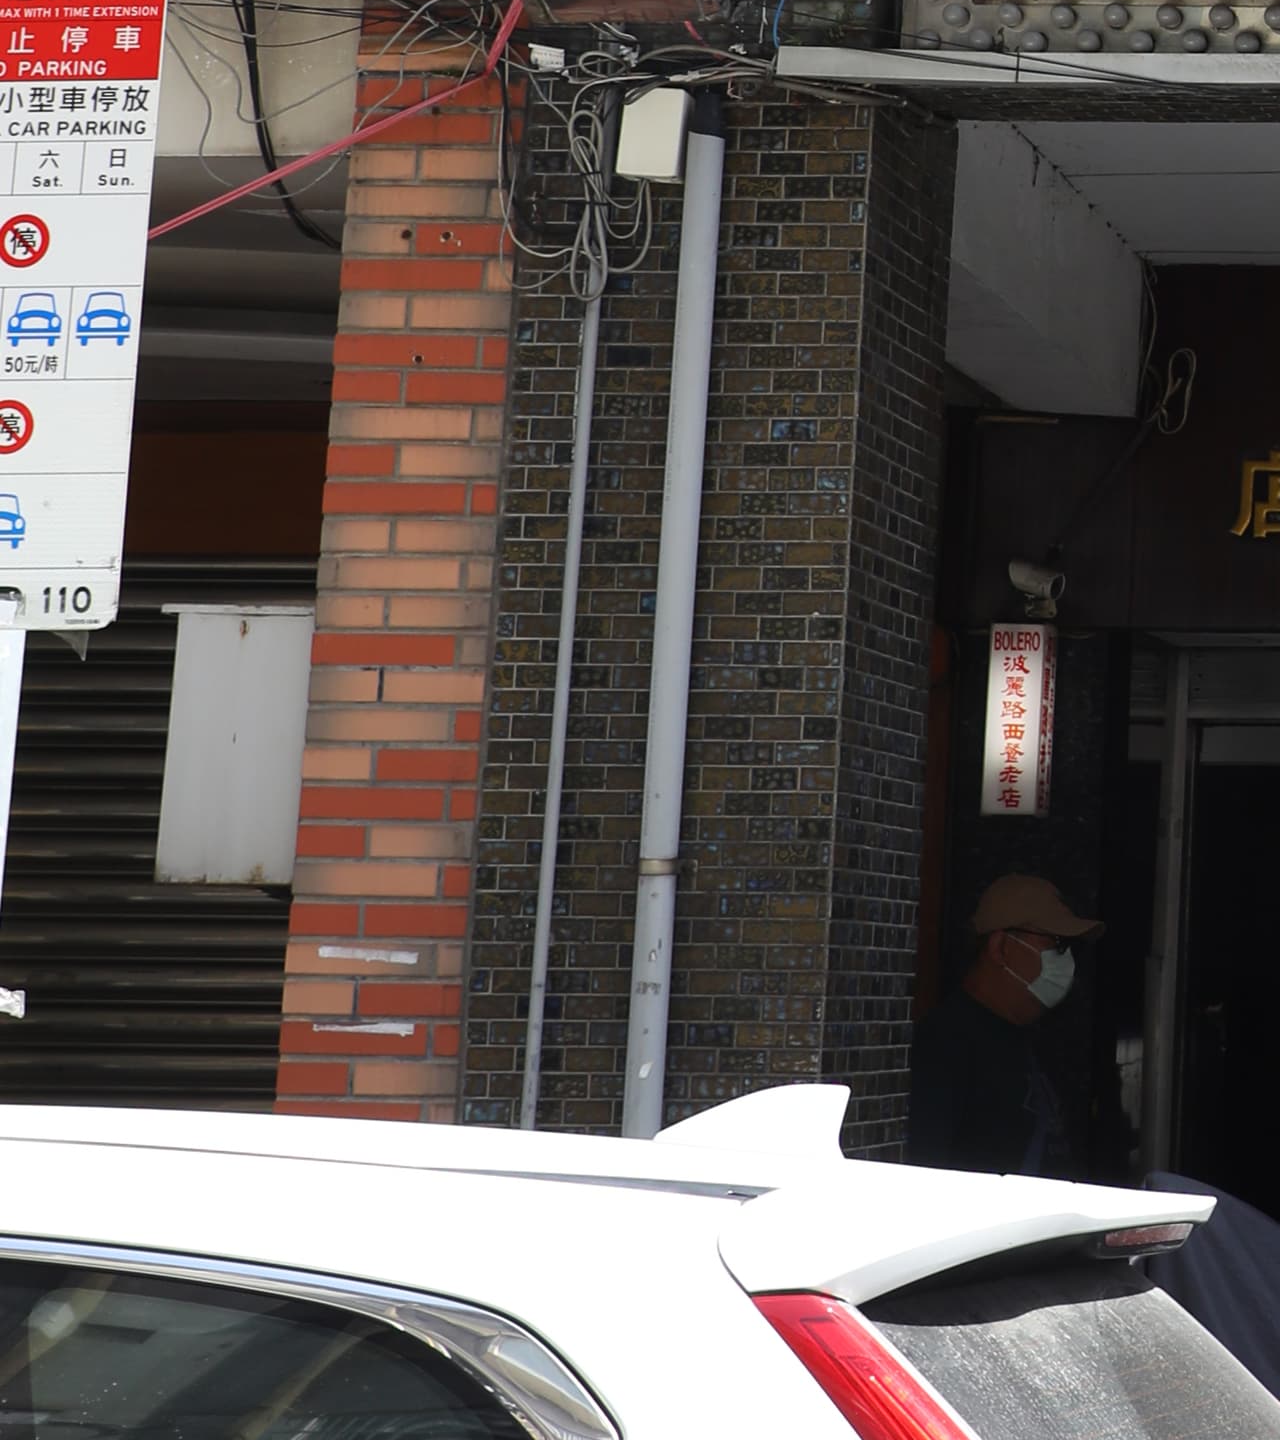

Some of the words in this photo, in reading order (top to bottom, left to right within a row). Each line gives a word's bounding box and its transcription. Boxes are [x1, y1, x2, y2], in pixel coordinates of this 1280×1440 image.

[24, 7, 51, 18] WITH
[55, 7, 59, 18] 1
[64, 7, 90, 17] TIME
[93, 5, 159, 17] EXTENSION
[18, 60, 108, 77] PARKING
[0, 86, 151, 113] 小型車停放
[8, 121, 50, 137] CAR
[56, 120, 147, 136] PARKING
[39, 149, 60, 169] 六
[109, 148, 127, 168] 日
[32, 175, 63, 188] Sat.
[98, 174, 135, 187] Sun.
[43, 586, 92, 614] 110
[994, 631, 1041, 651] BOLERO
